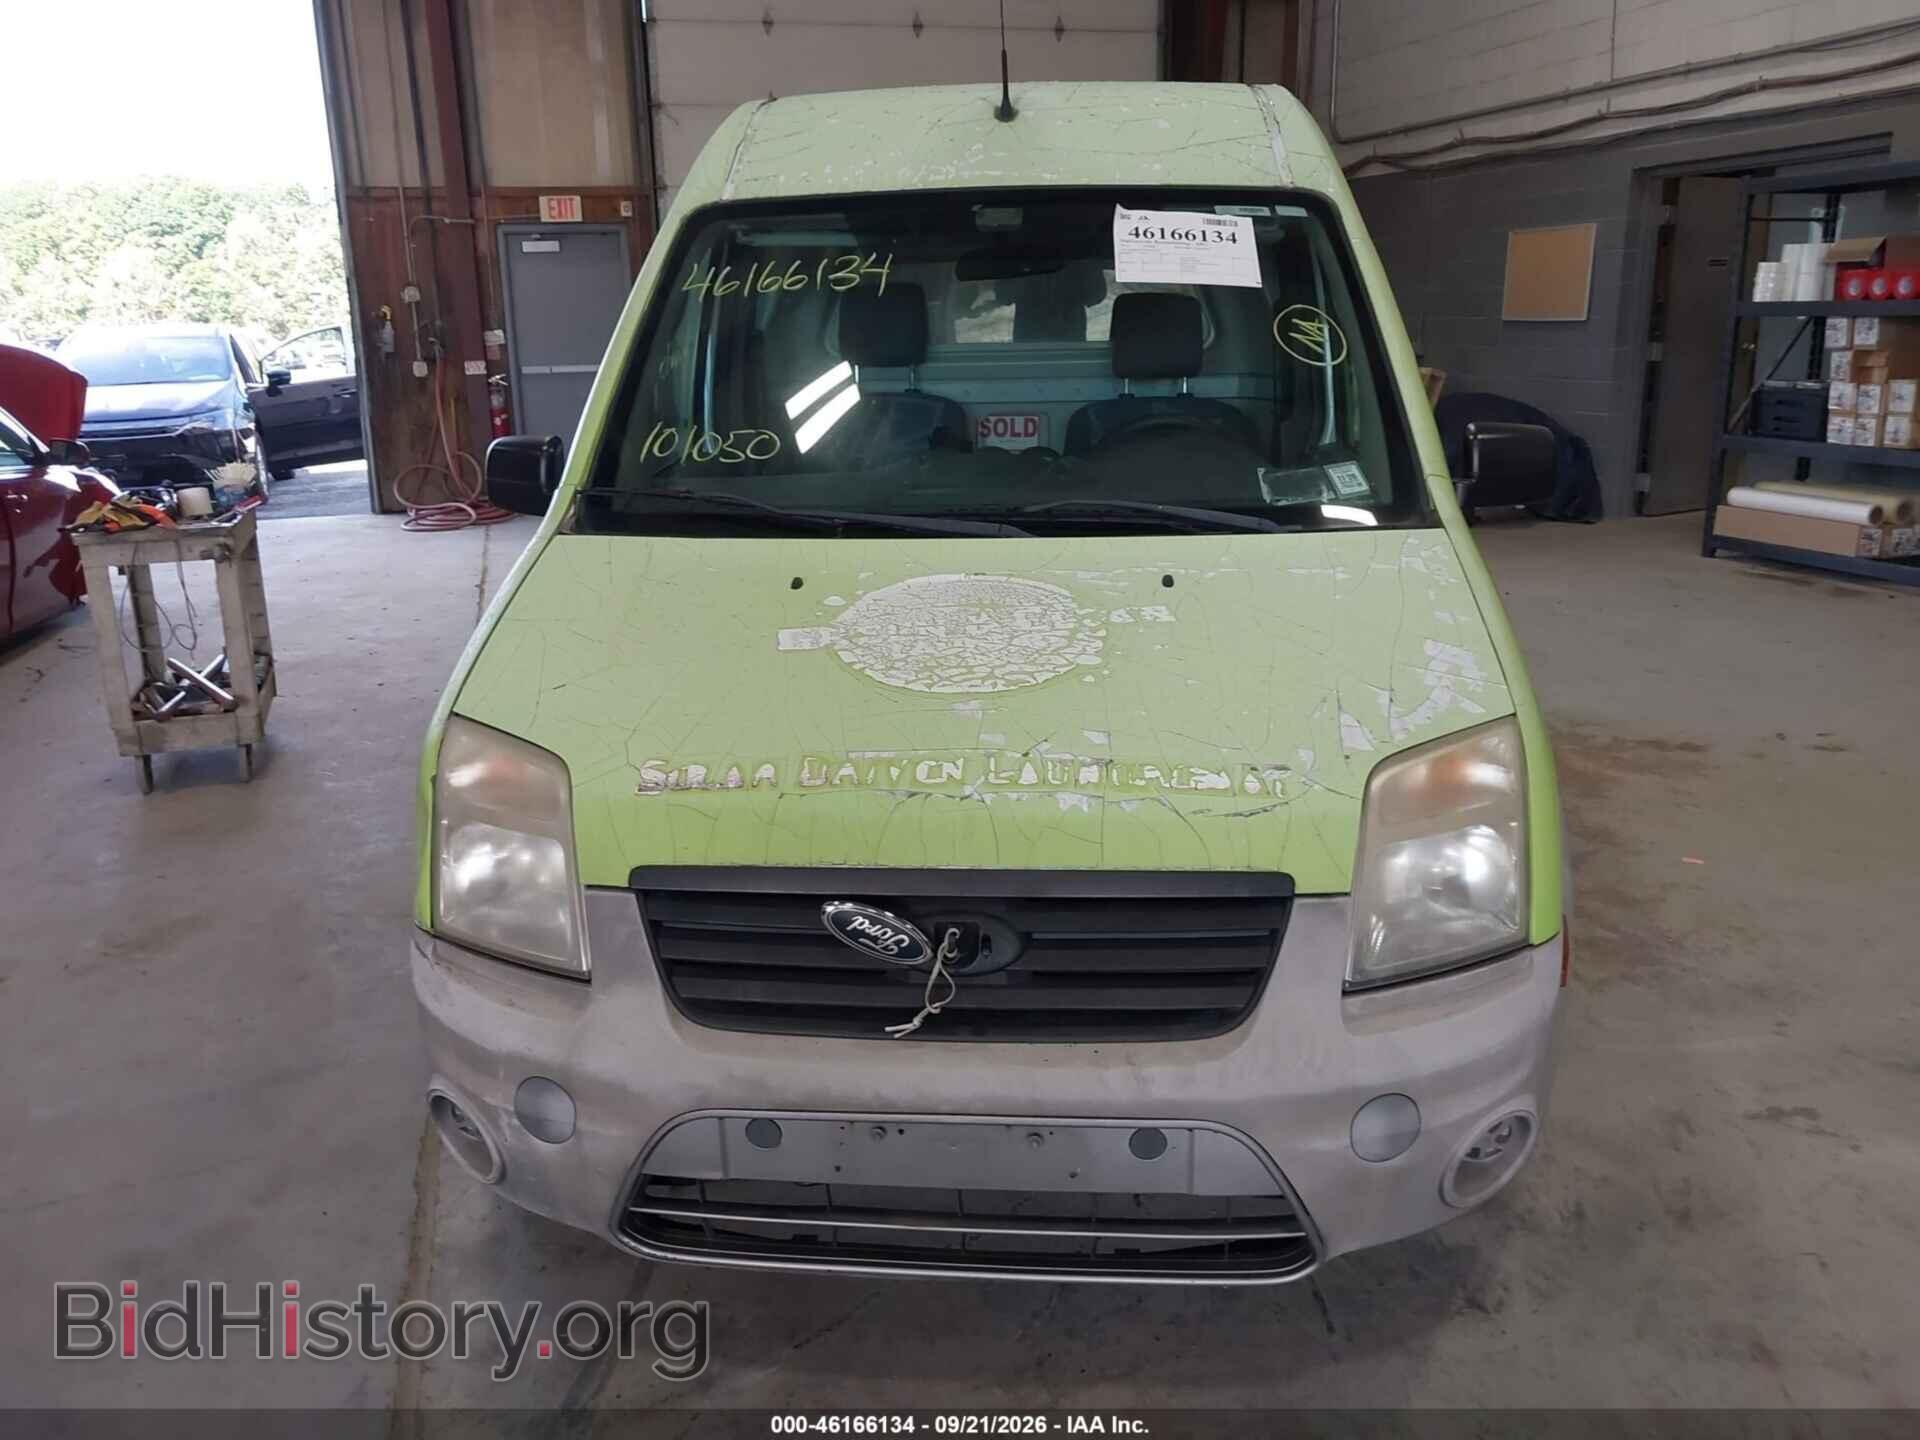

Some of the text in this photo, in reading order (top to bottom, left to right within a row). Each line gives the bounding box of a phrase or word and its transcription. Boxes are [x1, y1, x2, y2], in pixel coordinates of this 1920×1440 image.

[547, 197, 577, 219] EXIT
[1128, 225, 1238, 245] 46166134
[681, 252, 893, 302] 46166134
[639, 420, 781, 465] 101050
[979, 416, 1038, 438] SOLD
[846, 915, 910, 956] Ford
